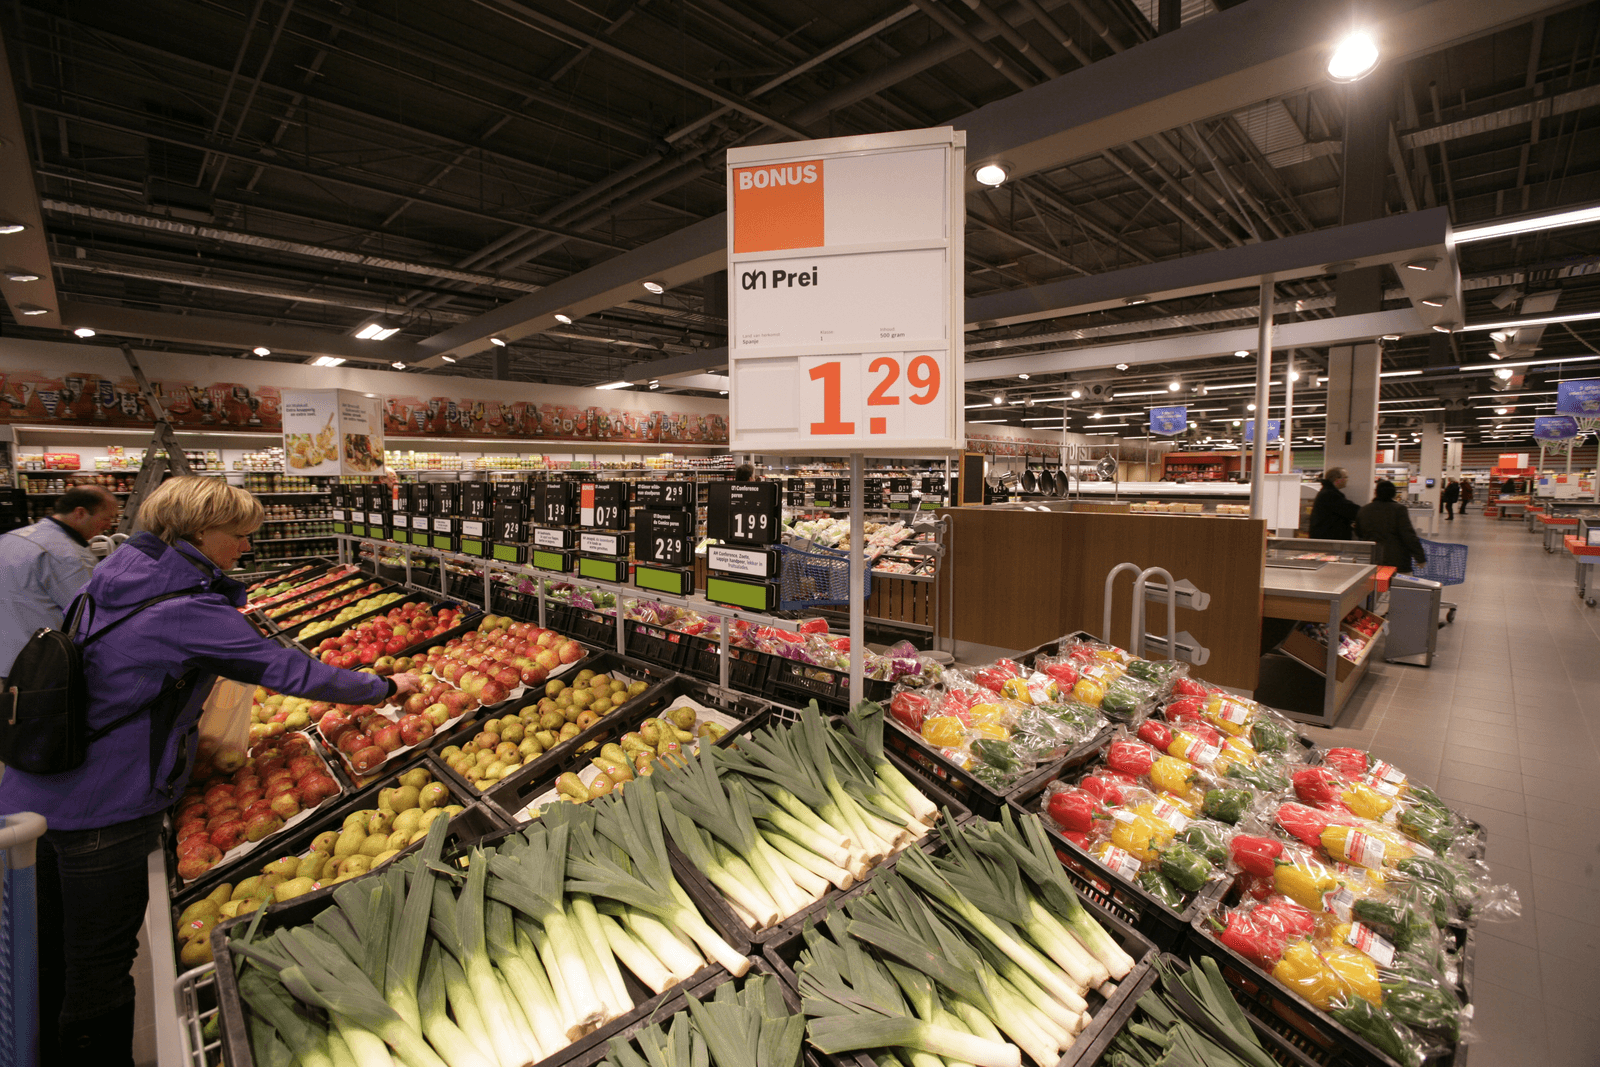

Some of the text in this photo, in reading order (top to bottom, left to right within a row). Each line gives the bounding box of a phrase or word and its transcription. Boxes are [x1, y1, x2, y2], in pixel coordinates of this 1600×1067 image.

[739, 164, 818, 190] BONUS
[772, 266, 818, 289] Prei
[808, 354, 941, 435] 1.29
[665, 486, 683, 501] 2.99
[547, 503, 565, 521] 1.39
[596, 506, 618, 526] 0.79
[504, 522, 519, 538] 2.29
[734, 513, 767, 539] 1.99
[655, 537, 682, 560] 2.29
